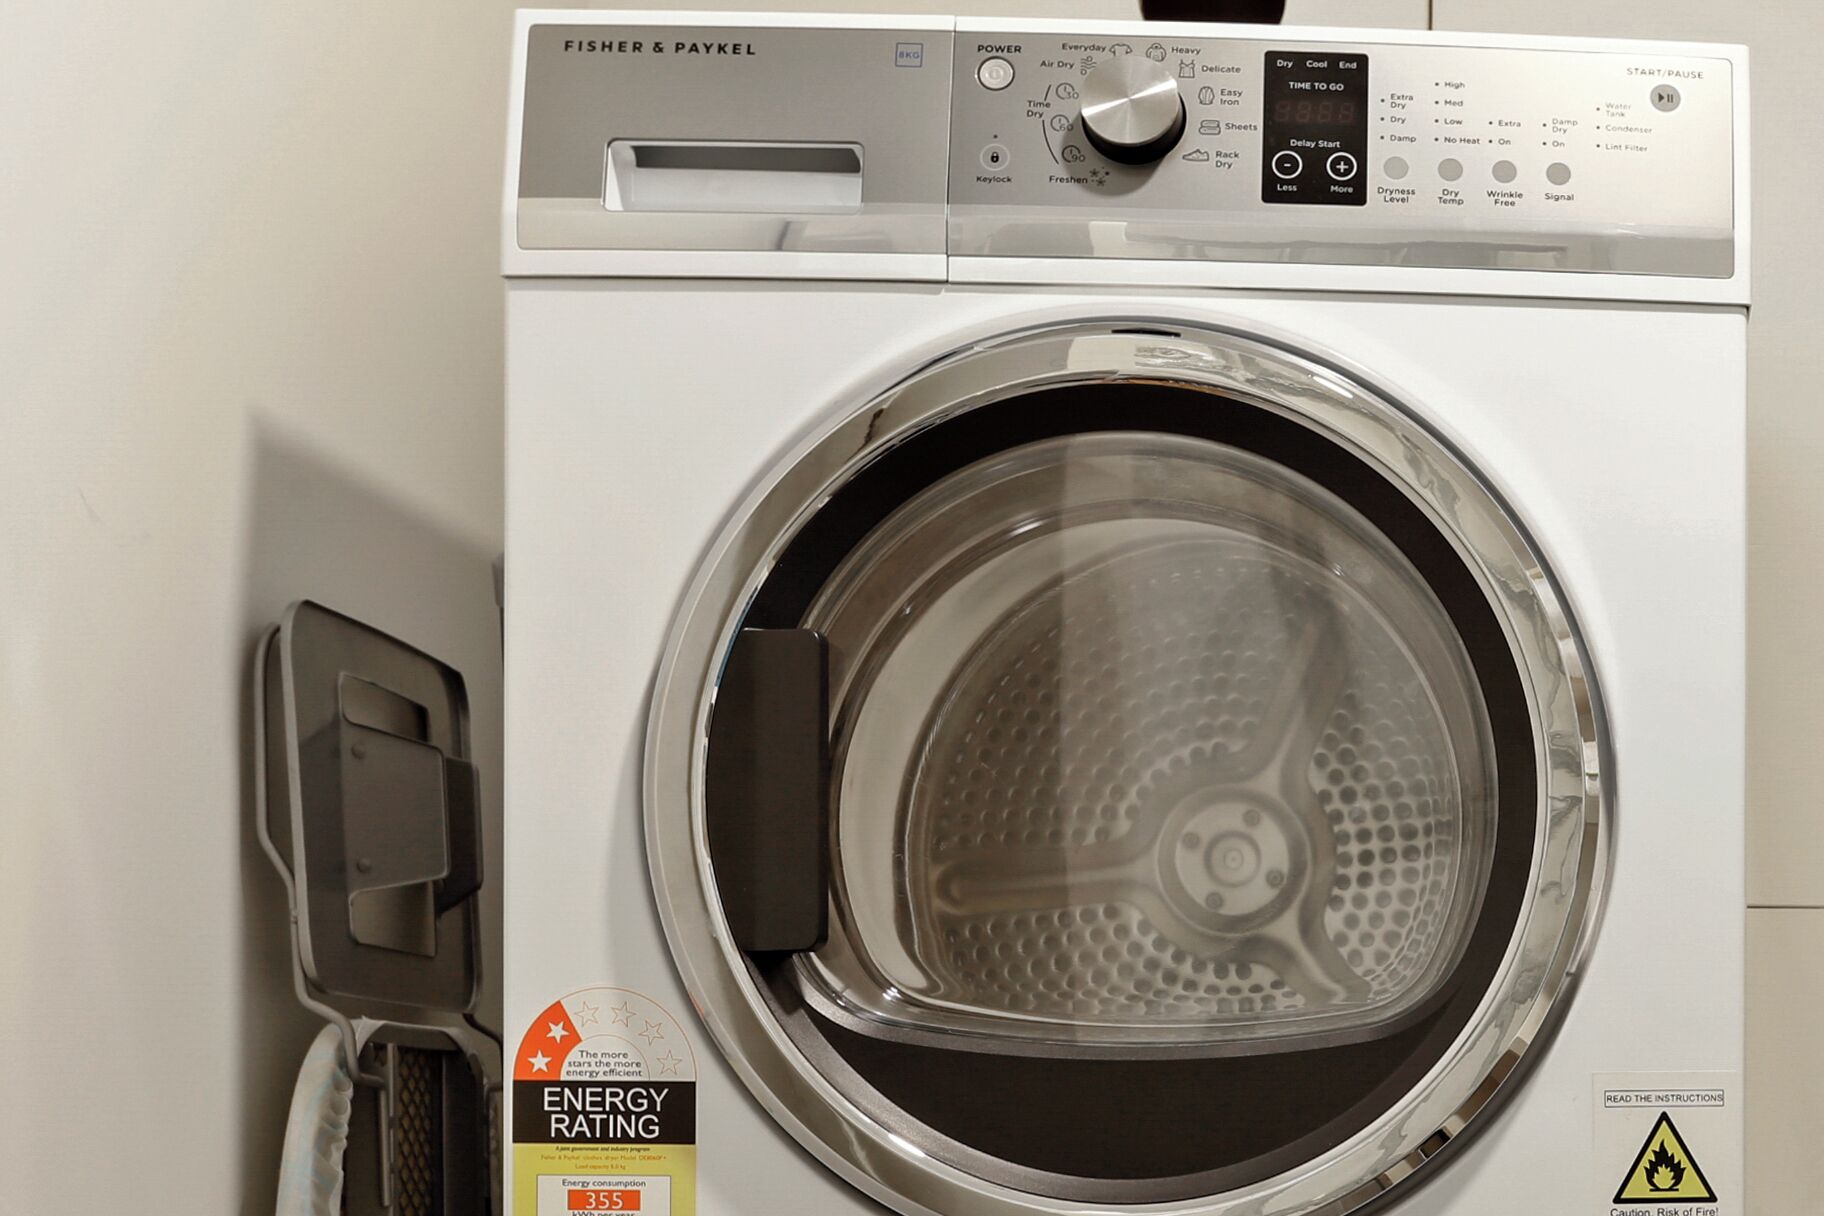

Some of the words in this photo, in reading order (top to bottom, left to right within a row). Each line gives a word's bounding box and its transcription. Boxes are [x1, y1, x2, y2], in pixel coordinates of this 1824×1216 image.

[564, 40, 643, 53] FISHER
[652, 41, 664, 54] &
[675, 42, 756, 55] PAYKEL
[977, 44, 1022, 54] POWER
[1062, 42, 1106, 53] Everyday
[1171, 46, 1201, 55] Heavy
[1057, 61, 1074, 69] Dry
[1277, 59, 1293, 68] Dry
[1306, 60, 1328, 68] Cool
[1339, 61, 1357, 70] End
[1201, 64, 1241, 74] Delicate
[1626, 67, 1704, 79] START/PAUSE
[1288, 81, 1312, 90] TIME
[1314, 82, 1327, 90] TO
[1329, 82, 1344, 91] GO
[1444, 81, 1465, 89] High
[1221, 88, 1243, 98] Easy
[1390, 93, 1413, 102] Extra
[1027, 100, 1051, 108] Time
[1220, 98, 1239, 106] Iron
[1390, 101, 1407, 110] Dry
[1444, 99, 1464, 107] Med
[1026, 110, 1043, 119] Dry
[1390, 116, 1407, 124] Dry
[1444, 118, 1463, 126] Low
[1498, 120, 1521, 128] Extra
[1225, 122, 1258, 131] Sheets
[1605, 124, 1652, 134] Condenser
[1390, 135, 1417, 143] Damp
[1460, 137, 1481, 145] Heat
[1498, 138, 1511, 146] On
[1290, 139, 1316, 149] Delay
[1318, 140, 1341, 148] Start
[1605, 143, 1622, 151] Lint
[1216, 150, 1239, 159] Rack
[1216, 160, 1233, 169] Dry
[976, 176, 1012, 184] Keylock
[1049, 175, 1088, 184] Freshen
[1277, 183, 1297, 192] Less
[1330, 185, 1353, 193] More
[1377, 187, 1416, 197] Dryness
[1442, 188, 1460, 198] Dry
[1487, 190, 1523, 199] Wrinkle
[1544, 192, 1575, 202] Signal
[1383, 196, 1409, 204] Level
[1438, 197, 1464, 206] Temp
[1494, 199, 1516, 207] Free
[578, 1050, 598, 1059] The
[601, 1051, 629, 1059] more
[568, 1060, 594, 1068] stars
[595, 1059, 612, 1068] the
[613, 1060, 642, 1068] more
[565, 1068, 600, 1078] energy
[602, 1068, 642, 1077] efficient
[543, 1087, 669, 1112] ENERGY
[1606, 1094, 1632, 1103] READ
[1635, 1094, 1652, 1103] THE
[1655, 1093, 1724, 1103] INSTRUCTIONS
[551, 1114, 660, 1139] RATING
[562, 1179, 590, 1188] Energy
[592, 1179, 647, 1188] consumption
[585, 1191, 624, 1209] 355
[1657, 1208, 1680, 1216] Risk
[1682, 1207, 1693, 1216] of
[1695, 1207, 1719, 1216] Fire!
